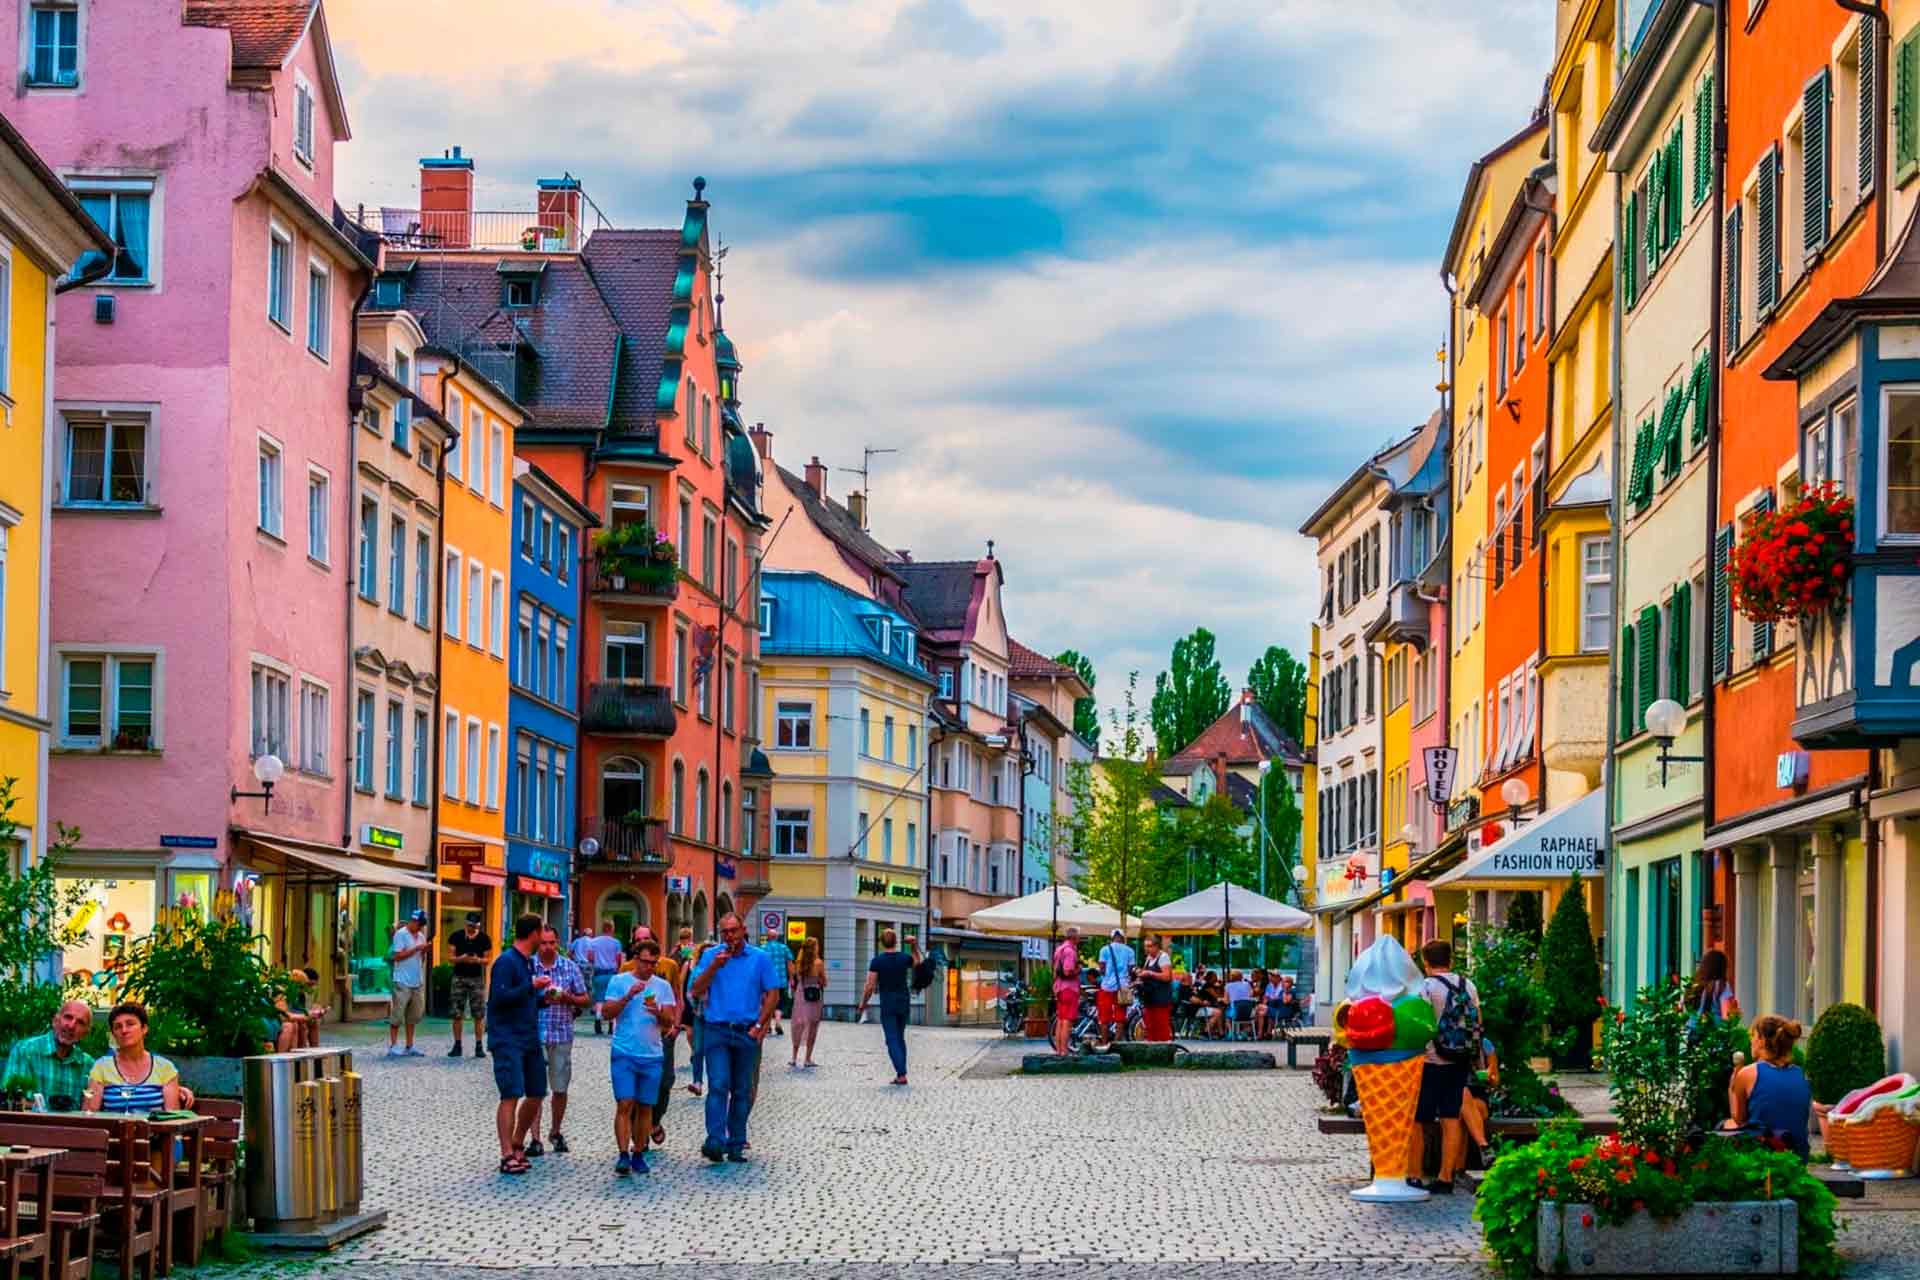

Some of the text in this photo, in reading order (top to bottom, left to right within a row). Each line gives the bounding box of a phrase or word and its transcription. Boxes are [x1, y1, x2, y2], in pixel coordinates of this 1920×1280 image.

[1434, 750, 1448, 800] HOTEL
[1541, 838, 1598, 852] RAPHAEL
[1494, 854, 1552, 869] FASHION
